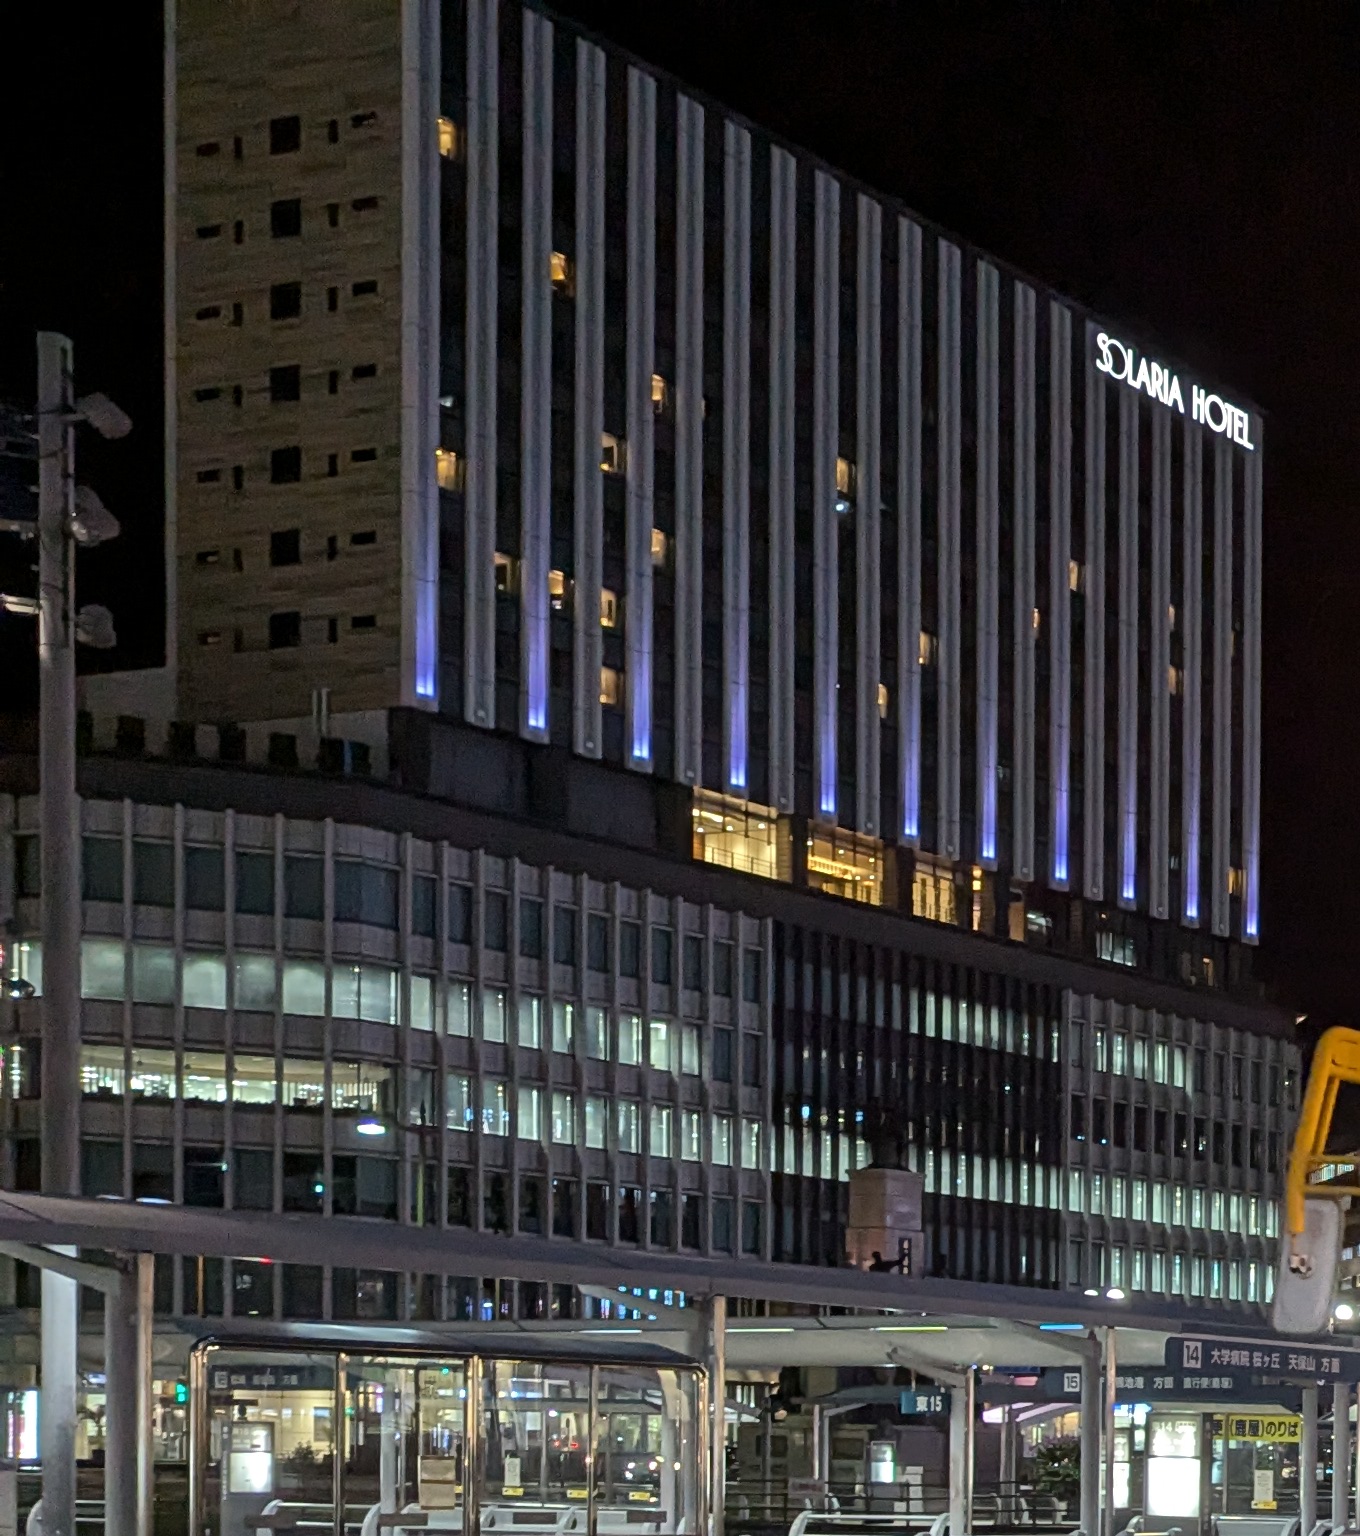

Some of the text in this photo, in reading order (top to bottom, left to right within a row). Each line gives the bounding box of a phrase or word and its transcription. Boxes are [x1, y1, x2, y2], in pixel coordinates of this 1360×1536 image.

[1096, 333, 1254, 450] SOLARIA HOTEL
[1185, 1344, 1199, 1365] 14
[1211, 1349, 1250, 1368] 大学病院
[1320, 1356, 1340, 1373] 方面
[1066, 1375, 1078, 1390] 15
